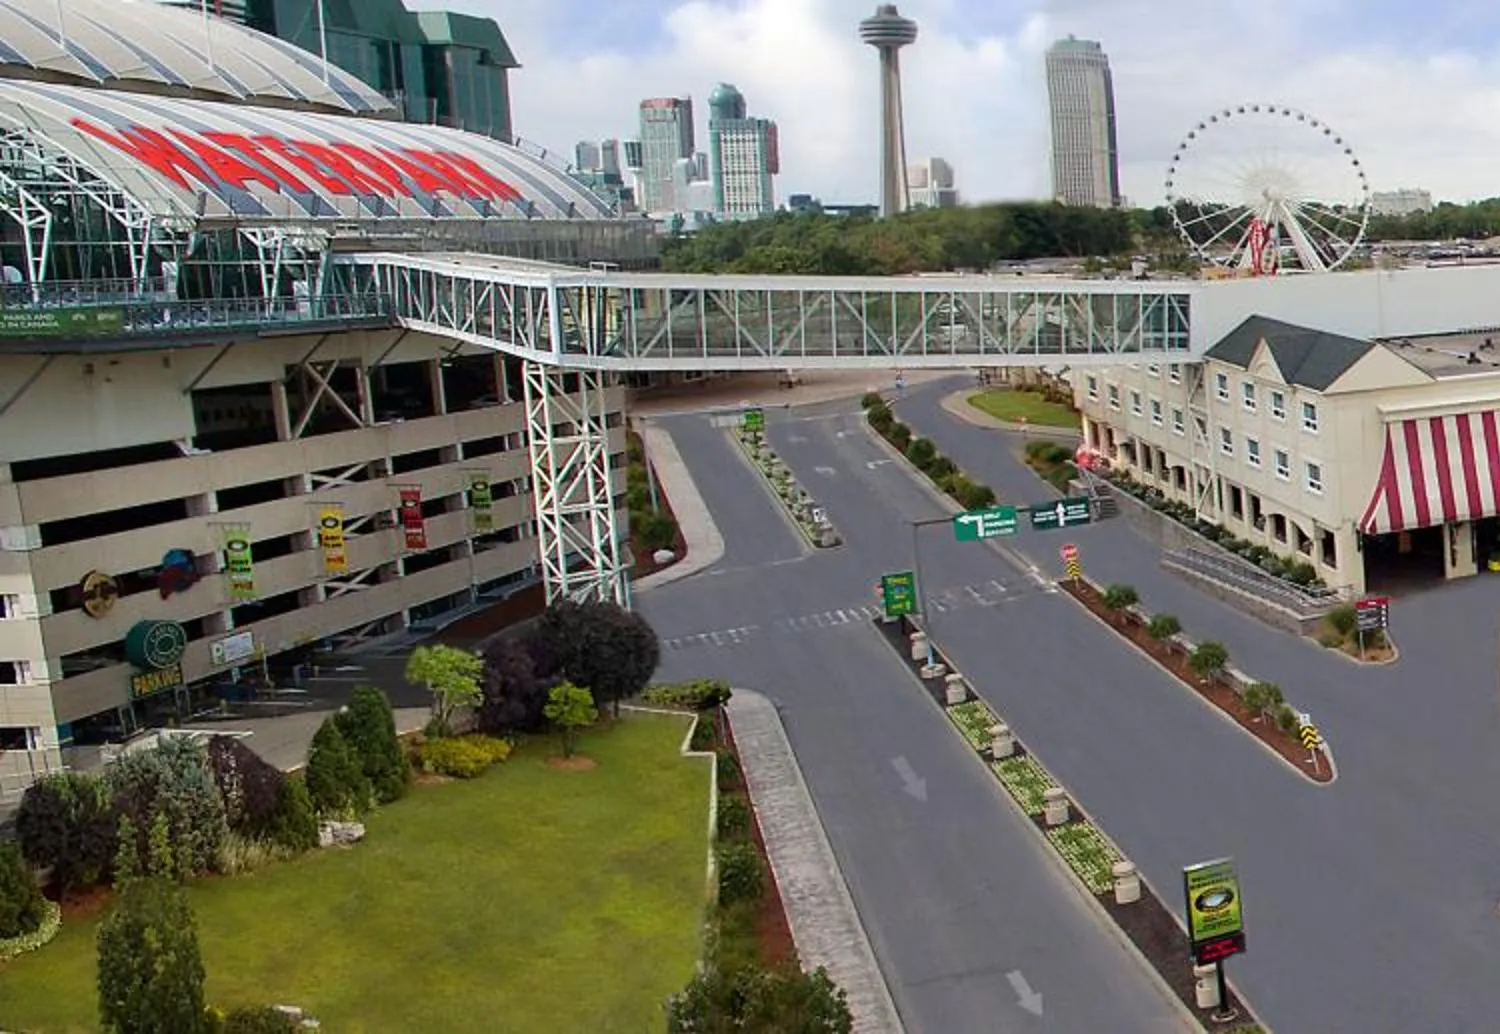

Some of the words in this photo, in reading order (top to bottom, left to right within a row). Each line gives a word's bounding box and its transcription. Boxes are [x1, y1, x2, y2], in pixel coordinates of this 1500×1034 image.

[70, 116, 524, 200] WATERPARK
[20, 321, 60, 329] CANADA
[133, 668, 182, 697] PARKING
